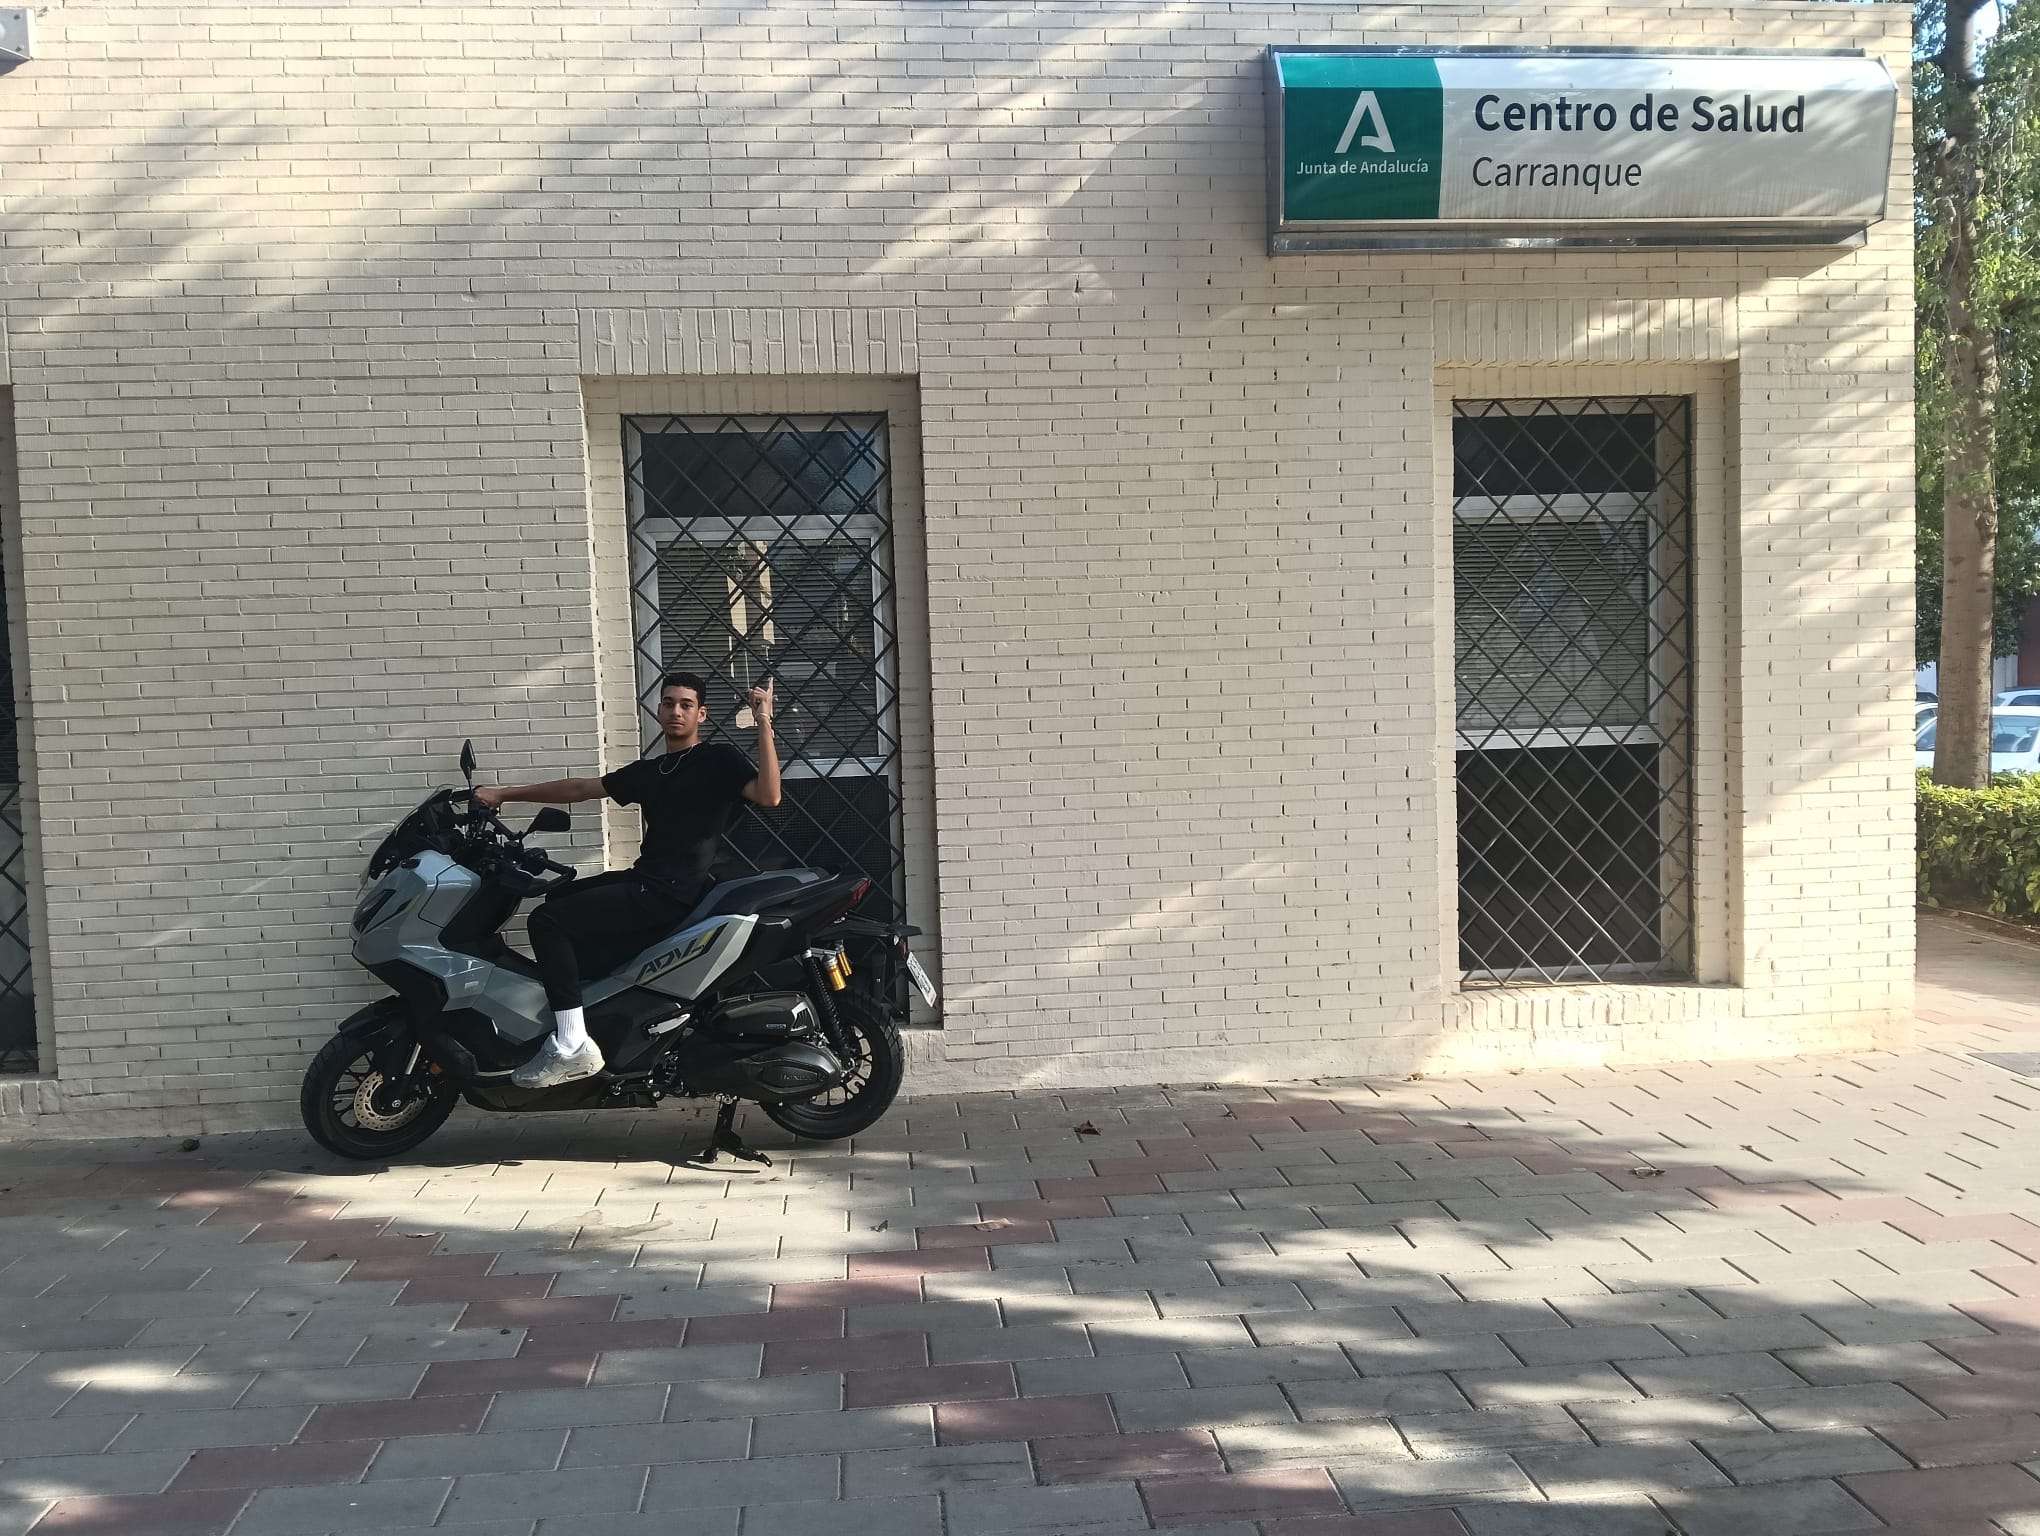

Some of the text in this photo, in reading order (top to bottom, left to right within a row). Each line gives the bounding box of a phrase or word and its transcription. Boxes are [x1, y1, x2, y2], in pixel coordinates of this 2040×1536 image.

[1475, 93, 1805, 133] Centro de Salud
[1296, 158, 1429, 175] Junta de Andalucía
[1472, 156, 1642, 194] Carranque
